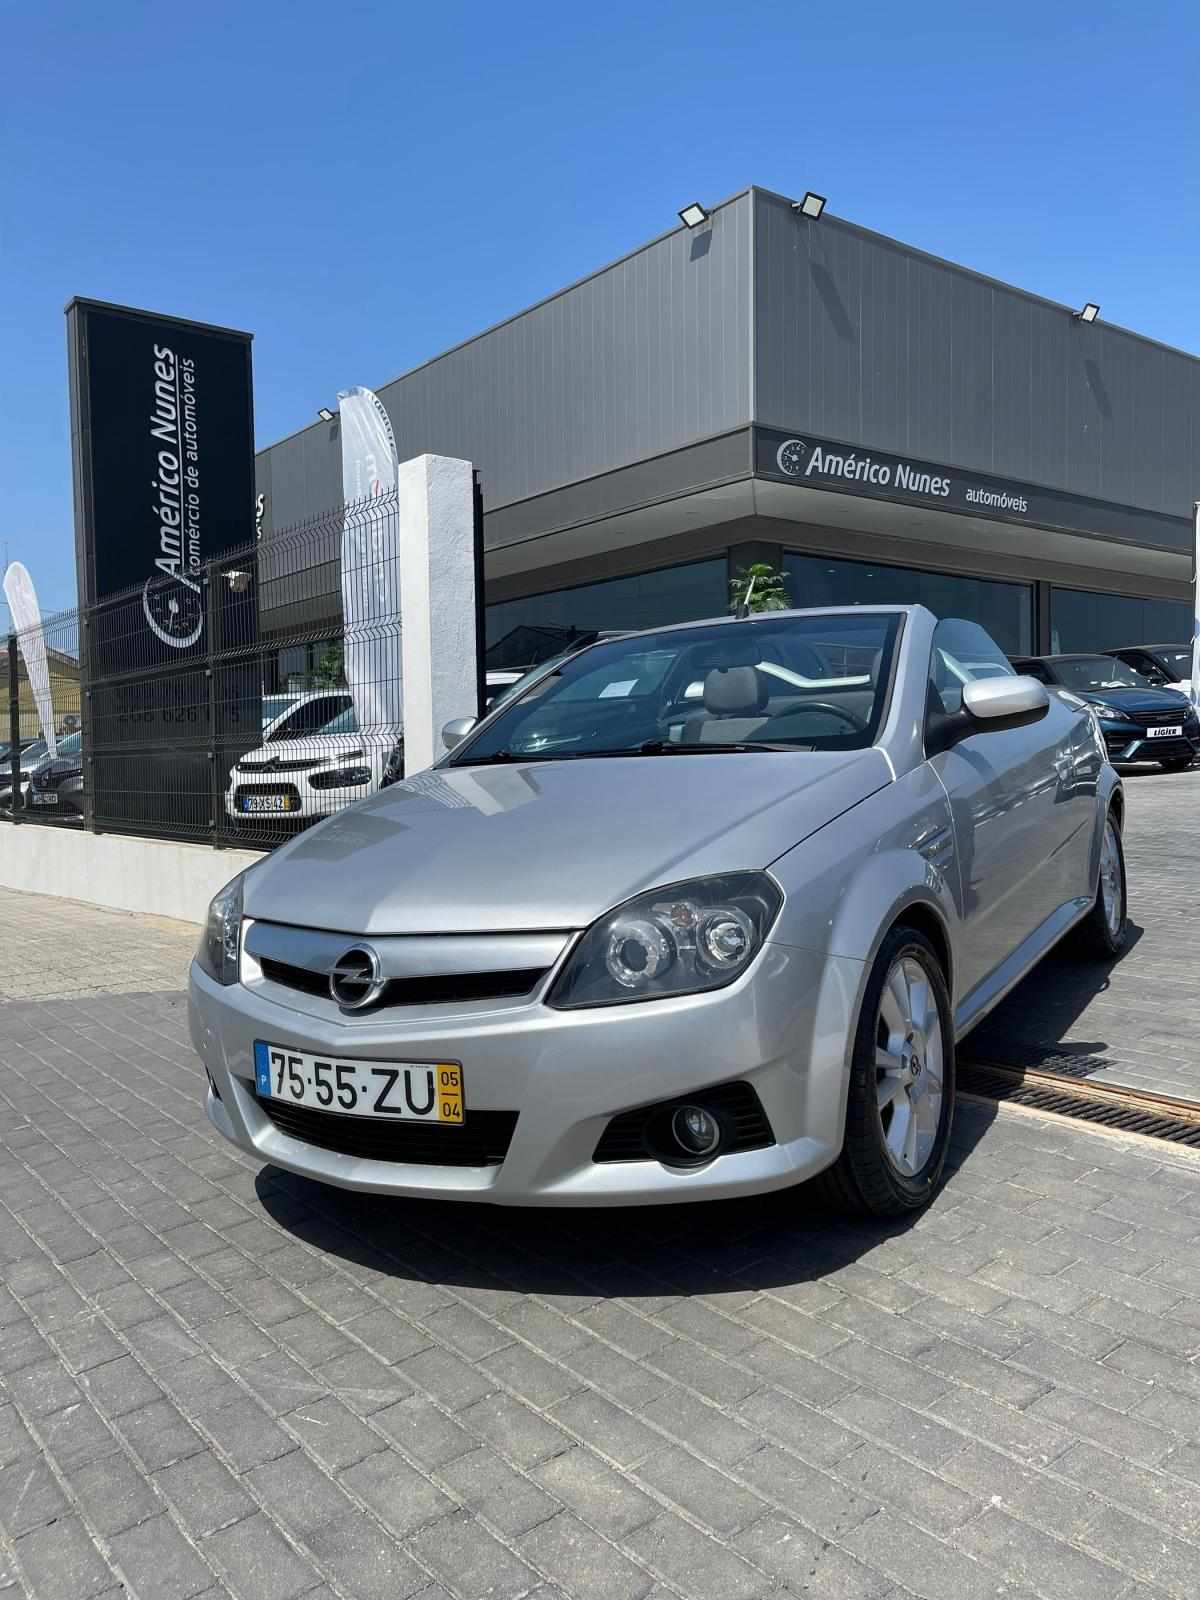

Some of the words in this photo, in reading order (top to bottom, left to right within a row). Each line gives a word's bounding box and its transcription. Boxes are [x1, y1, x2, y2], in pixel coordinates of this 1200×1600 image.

[150, 343, 177, 444] Nunes
[180, 358, 198, 461] automóveis
[184, 465, 199, 488] de
[805, 446, 891, 485] Américo
[894, 463, 950, 497] Nunes
[965, 487, 1028, 513] automóveis
[152, 450, 200, 593] Américo
[185, 494, 201, 577] comércio
[441, 1071, 458, 1087] 05
[443, 1102, 460, 1118] 04
